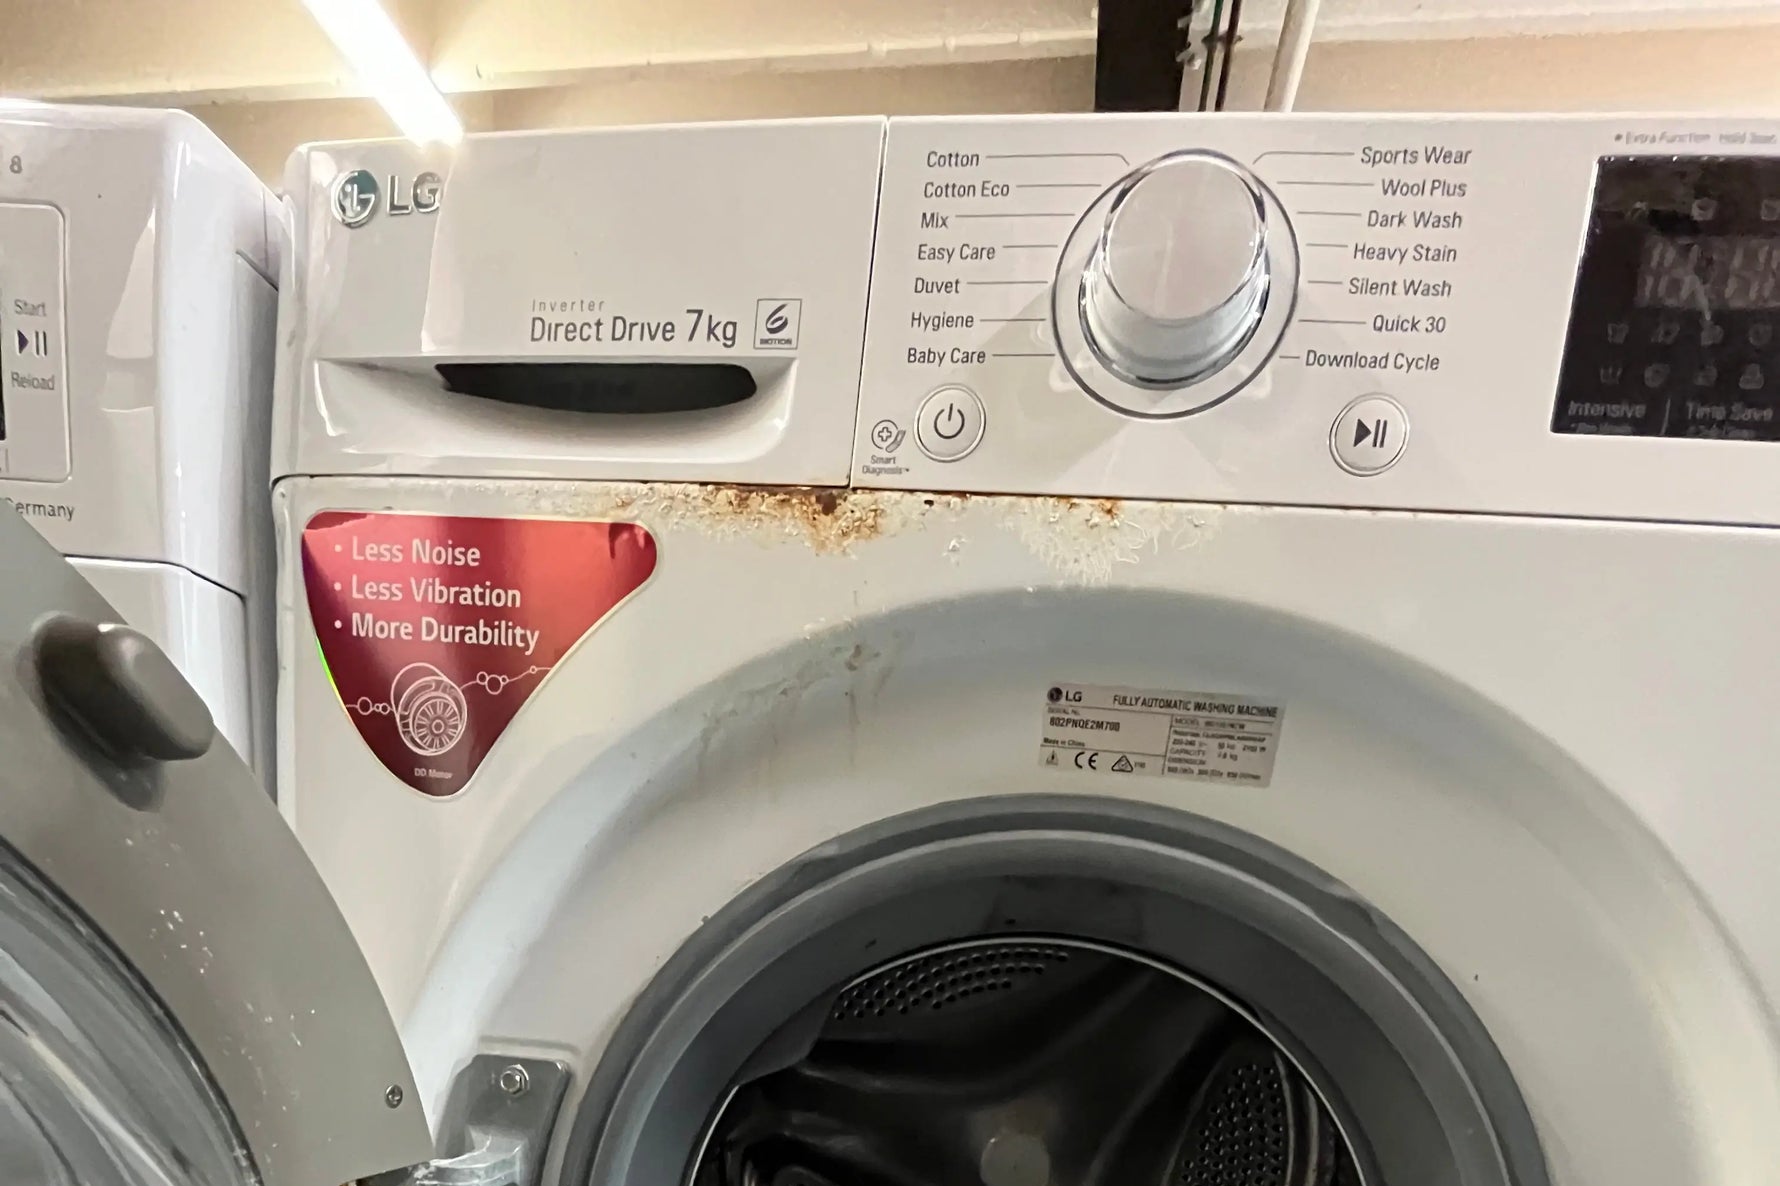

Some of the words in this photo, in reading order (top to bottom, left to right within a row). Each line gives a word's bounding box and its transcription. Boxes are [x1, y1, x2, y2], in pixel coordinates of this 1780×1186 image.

[9, 155, 23, 174] 8
[926, 150, 980, 169] Cotton
[1360, 146, 1418, 168] Sports
[1424, 145, 1472, 165] Wear
[923, 181, 976, 199] Cotton
[981, 180, 1010, 198] Eco
[1381, 178, 1426, 197] Wool
[1430, 179, 1467, 198] Plus
[920, 211, 949, 229] Mix
[1367, 209, 1407, 229] Dark
[1413, 210, 1463, 229] Wash
[917, 243, 955, 264] Easy
[959, 243, 996, 261] Care
[1353, 242, 1408, 265] Heavy
[1412, 243, 1458, 262] Stain
[913, 277, 961, 294] Duvet
[1348, 277, 1398, 295] Silent
[1403, 278, 1452, 298] Wash
[13, 299, 48, 317] Start
[532, 299, 605, 312] Inverter
[530, 315, 603, 342] Direct
[610, 316, 676, 342] Drive
[910, 312, 975, 332] Hygiene
[1372, 314, 1421, 333] Quick
[1425, 315, 1447, 333] 30
[906, 347, 947, 367] Baby
[950, 347, 987, 364] Care
[1305, 349, 1389, 370] Download
[1394, 351, 1440, 374] Cycle
[10, 371, 56, 391] Reload
[1567, 400, 1647, 419] Intensive
[6, 497, 75, 522] ermany
[351, 536, 403, 563] Less
[411, 538, 481, 567] Noise
[351, 574, 403, 602] Less
[410, 577, 522, 608] Vibration
[351, 612, 413, 641] More
[421, 617, 540, 656] Durability
[1065, 690, 1083, 703] LG
[1113, 694, 1141, 707] FULLY
[1141, 696, 1191, 712] AUTOMATIC
[1193, 700, 1235, 715] WASHING
[1236, 704, 1279, 718] MACHINE
